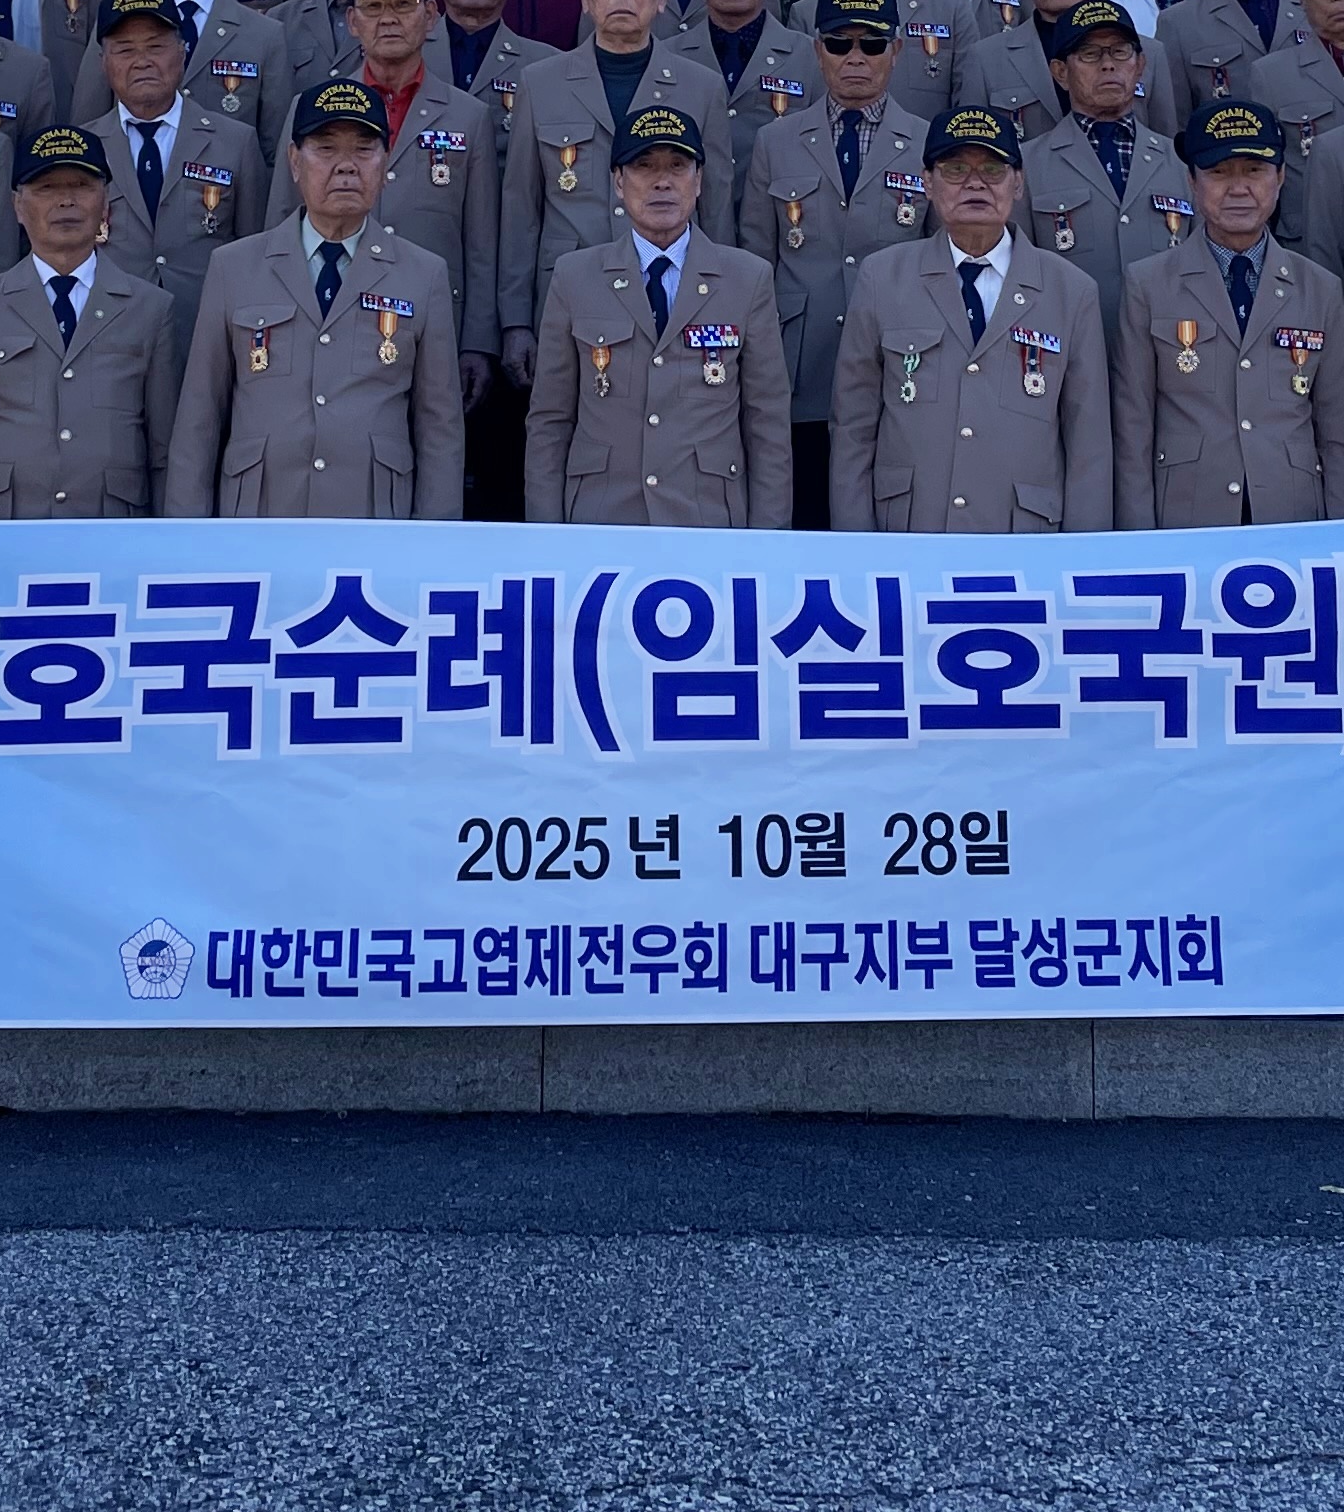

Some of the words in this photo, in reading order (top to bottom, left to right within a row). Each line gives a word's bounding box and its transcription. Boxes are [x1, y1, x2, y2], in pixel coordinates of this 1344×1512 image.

[315, 84, 354, 106] VIETNAM
[323, 103, 366, 113] VETERANS
[631, 110, 668, 134] VIETNAM
[946, 110, 984, 133] VIETNAM
[1206, 108, 1243, 133] VIETNAM
[31, 129, 70, 154] VIETNAM
[638, 127, 682, 137] VETERANS
[952, 129, 996, 138] VETERANS
[1214, 128, 1258, 138] VETERANS
[39, 147, 84, 158] VETERANS
[457, 817, 611, 882] 2025
[718, 812, 848, 879] 10월
[884, 810, 1011, 877] 28일
[206, 921, 729, 999] 대한민국고엽제전우회
[750, 919, 954, 992] 대구지부
[968, 913, 1225, 988] 달성군지회
